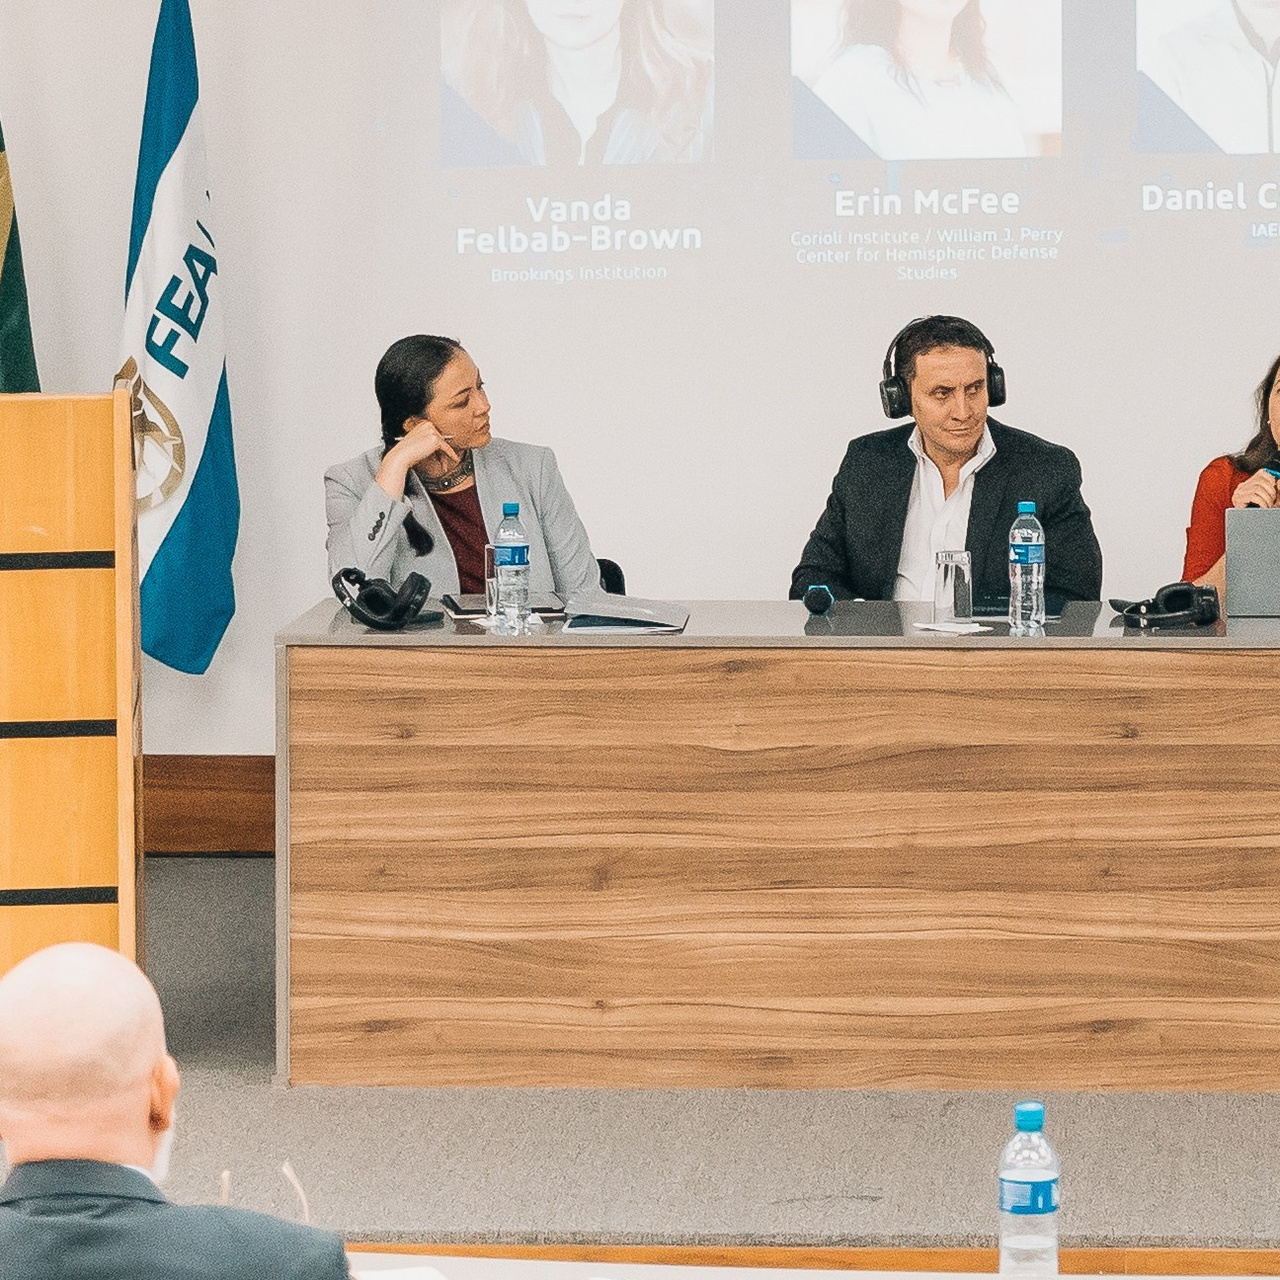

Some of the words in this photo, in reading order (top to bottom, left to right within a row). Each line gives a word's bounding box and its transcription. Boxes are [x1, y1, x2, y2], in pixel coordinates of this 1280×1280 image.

[526, 194, 631, 222] Vanda
[835, 188, 902, 217] Erin
[914, 188, 1020, 214] McFee
[1142, 182, 1247, 211] Daniel
[456, 225, 702, 254] Felbab-Brown
[849, 230, 920, 244] Institute
[936, 228, 997, 242] William
[1020, 228, 1063, 244] Perry
[796, 248, 850, 263] Center
[856, 248, 880, 262] for
[886, 246, 985, 264] Hemispheric
[992, 246, 1058, 260] Defense
[491, 268, 574, 284] Brookings
[578, 266, 667, 280] Institution
[898, 266, 957, 280] Studies
[145, 219, 217, 380] FEA
